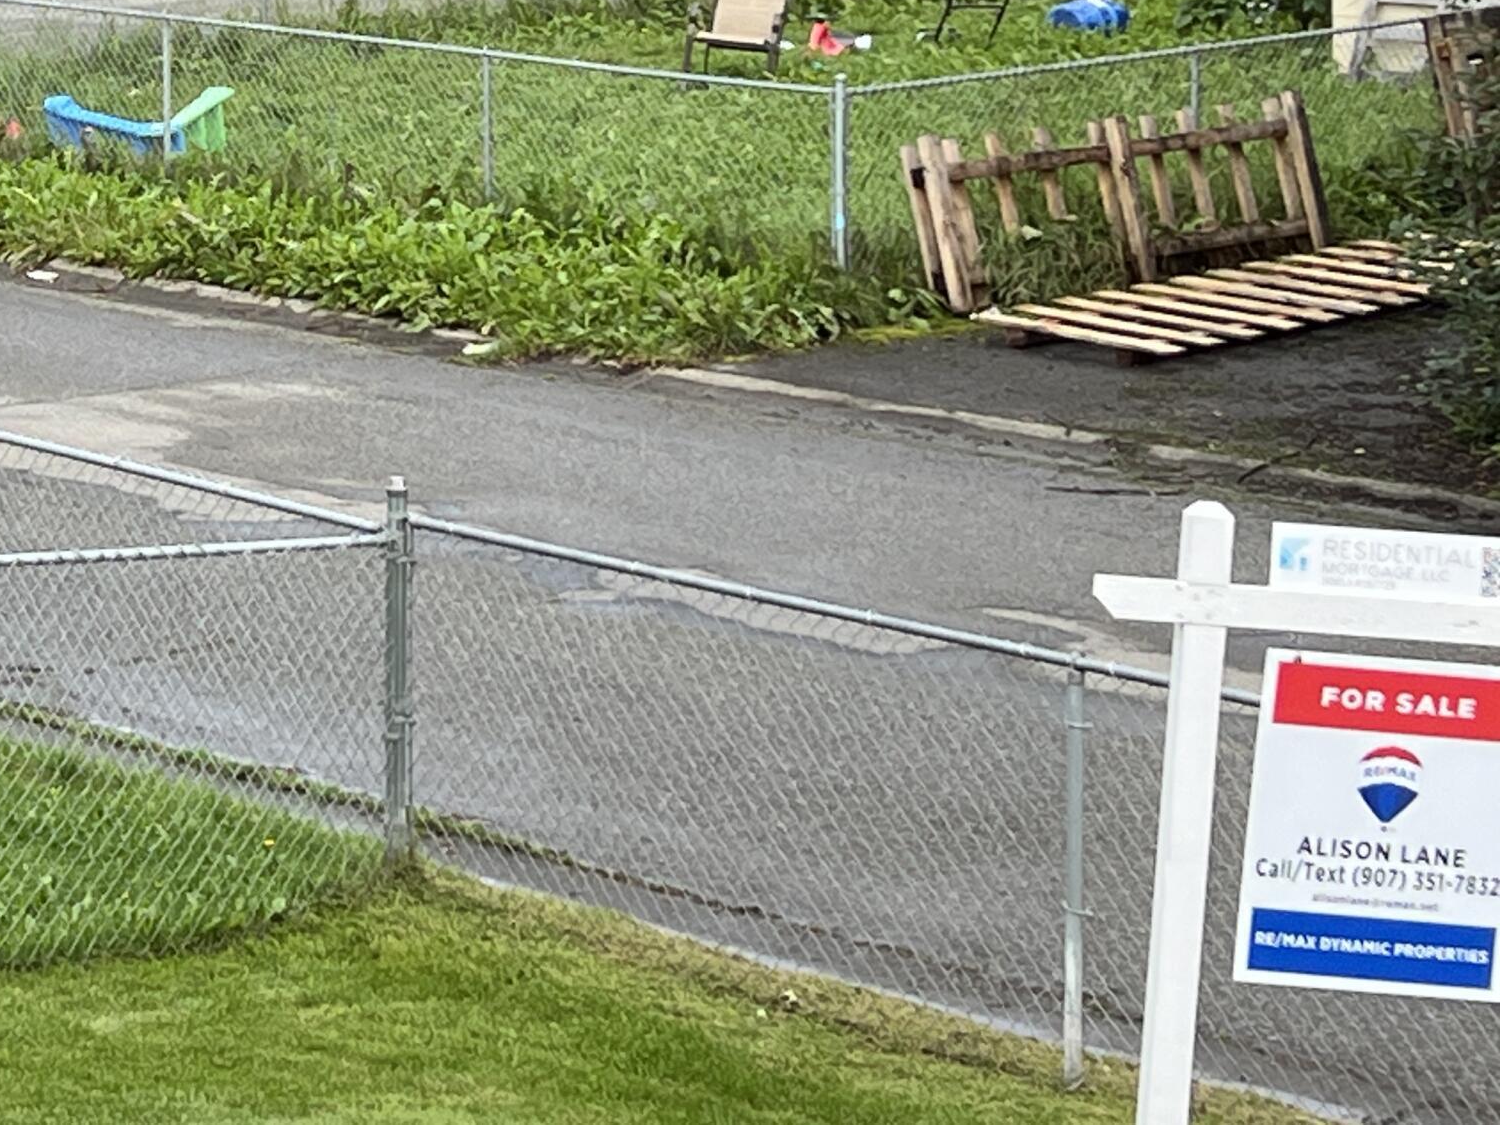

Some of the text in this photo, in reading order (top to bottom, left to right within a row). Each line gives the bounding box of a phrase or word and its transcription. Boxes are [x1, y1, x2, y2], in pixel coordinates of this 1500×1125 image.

[1322, 538, 1477, 569] RESIDENTIAL
[1421, 568, 1451, 583] LLC
[1320, 686, 1479, 720] FOR SALE
[1297, 836, 1468, 869] ALISON LANE
[1255, 857, 1500, 897] Call/Text (907) 351-7832
[1254, 930, 1490, 965] RE/MAX DYNAMIC PROPERTIES
